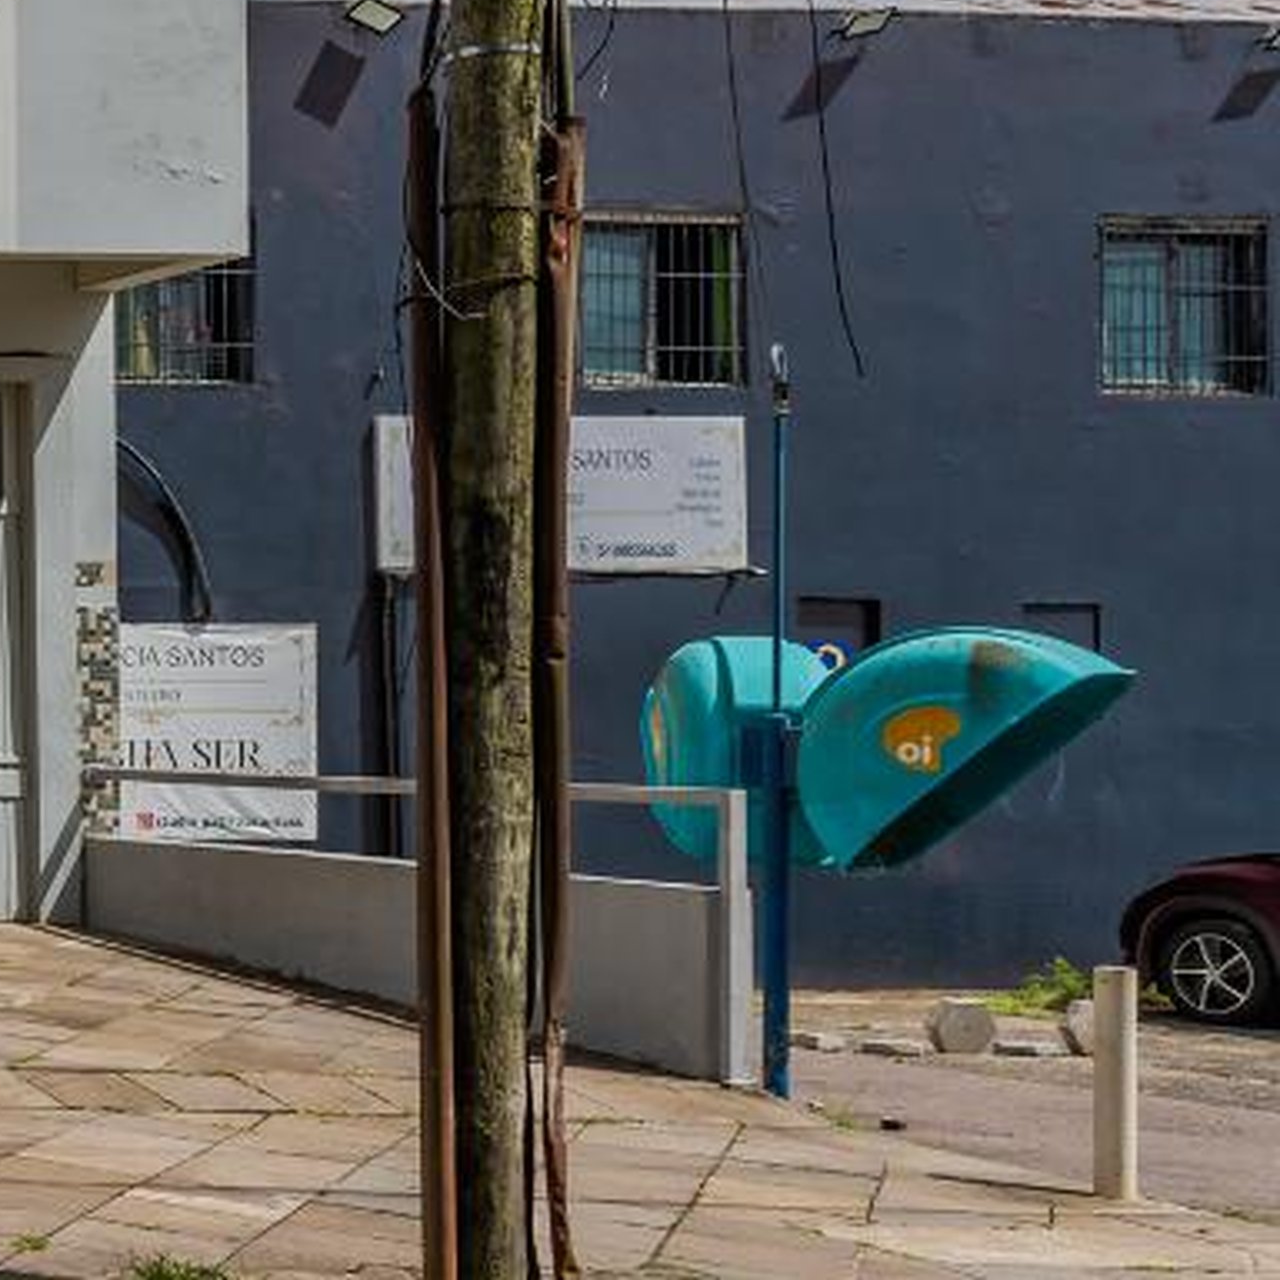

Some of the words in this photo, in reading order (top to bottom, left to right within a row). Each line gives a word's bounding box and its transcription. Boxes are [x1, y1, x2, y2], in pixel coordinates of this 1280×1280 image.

[570, 449, 653, 472] SANTOS
[166, 645, 265, 668] SANTOS
[896, 734, 933, 766] oi
